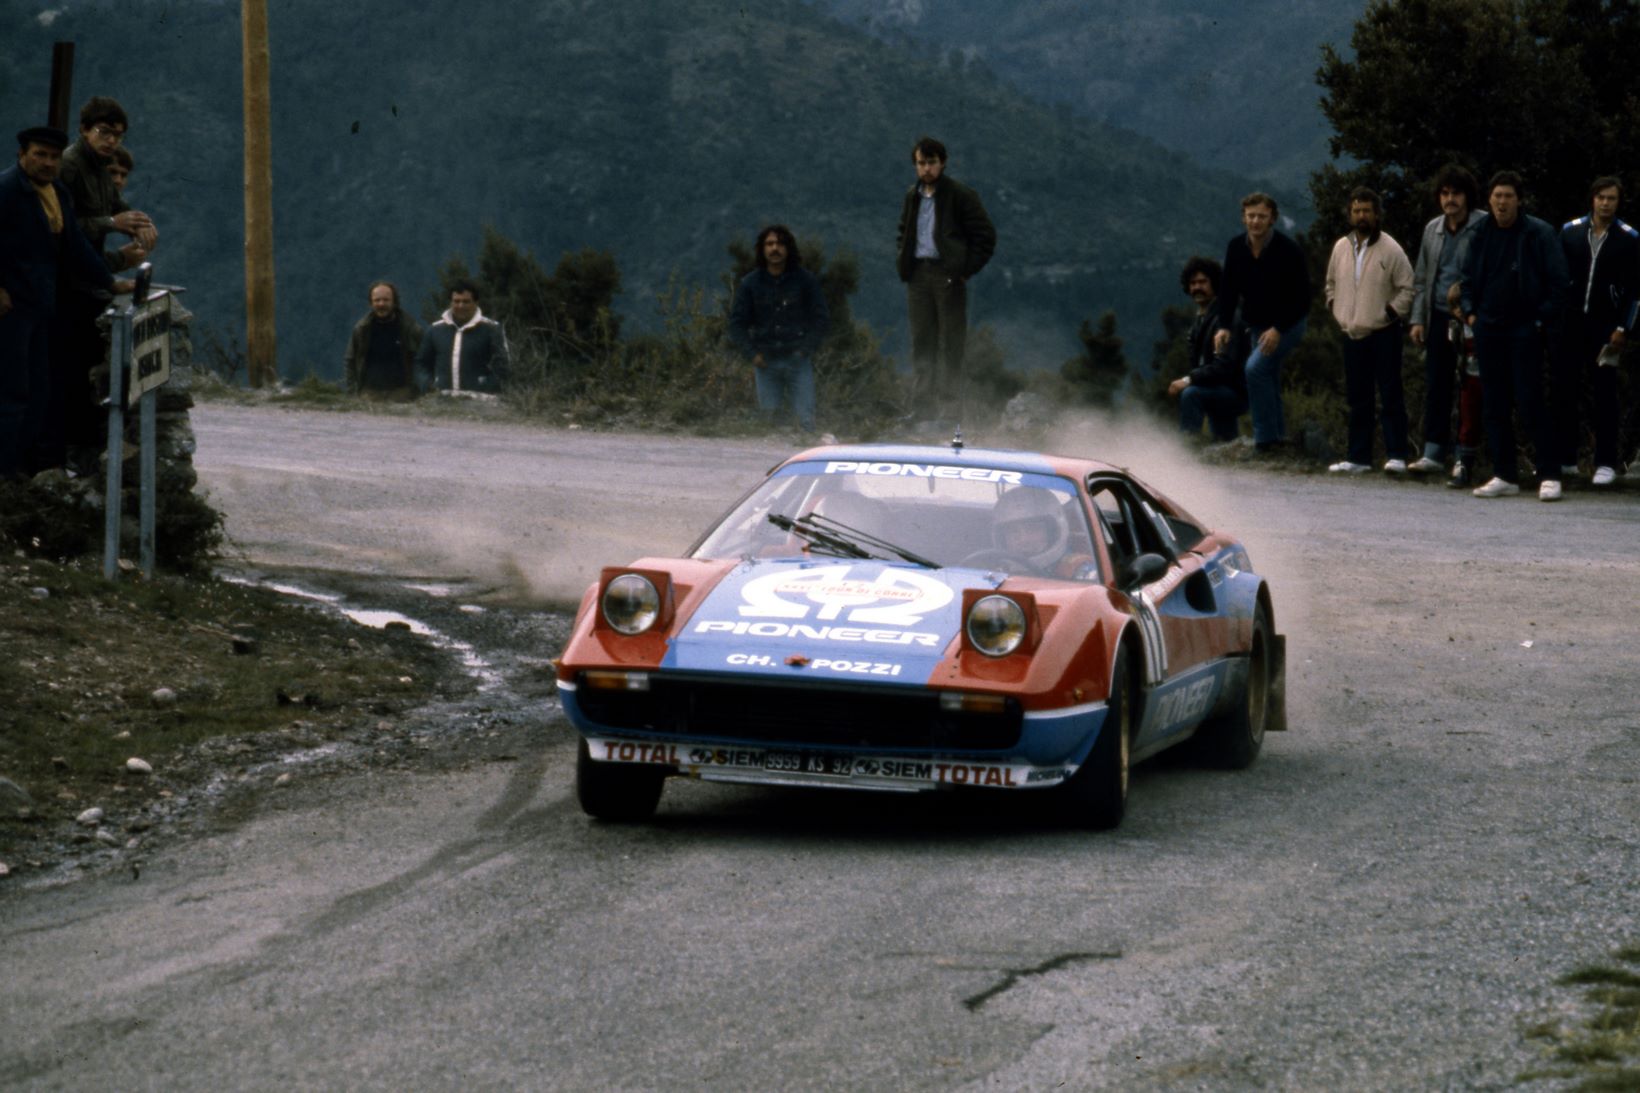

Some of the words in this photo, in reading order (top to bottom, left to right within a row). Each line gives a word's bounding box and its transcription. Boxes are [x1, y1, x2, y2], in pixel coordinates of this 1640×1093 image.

[824, 461, 1023, 484] PIONEER
[694, 621, 940, 646] PIONEER
[726, 653, 777, 667] CH.
[811, 659, 902, 676] POZZI
[604, 741, 681, 765] TOTAL
[767, 753, 801, 770] 9959
[832, 758, 850, 774] 92
[880, 758, 933, 780] SIEM
[935, 764, 1018, 787] TOTAL
